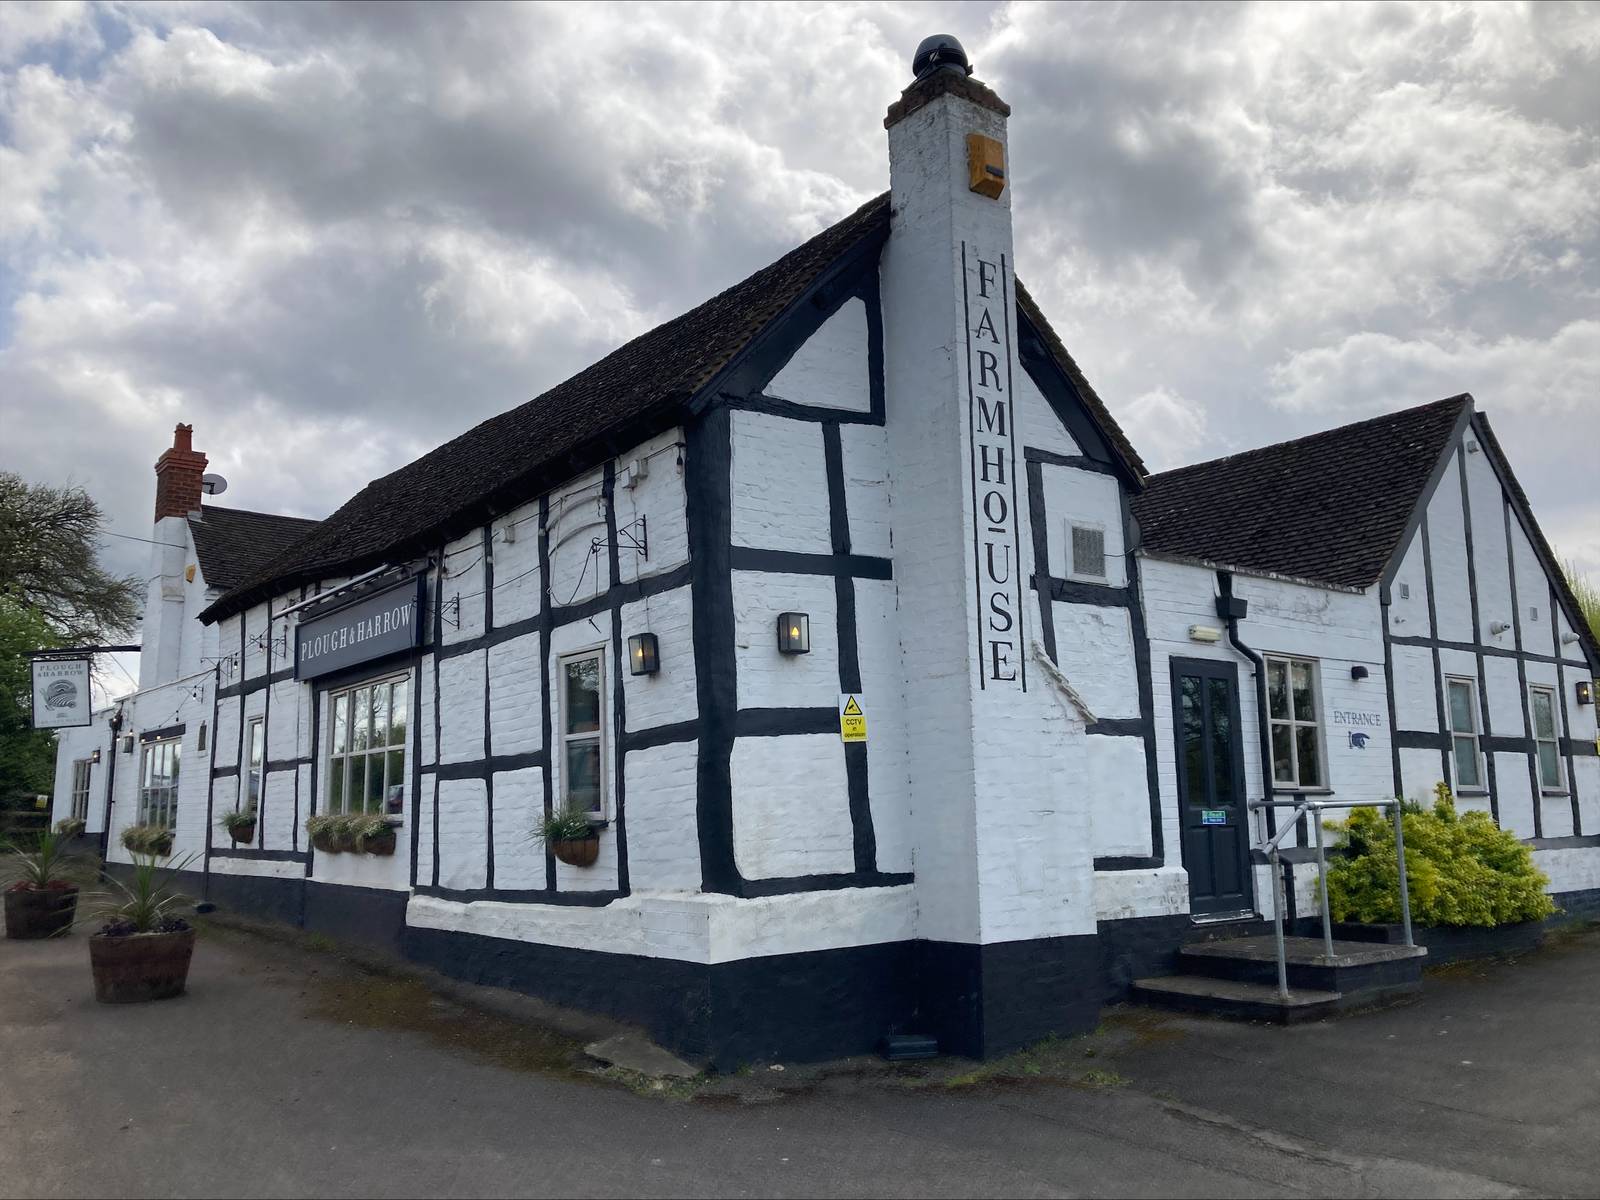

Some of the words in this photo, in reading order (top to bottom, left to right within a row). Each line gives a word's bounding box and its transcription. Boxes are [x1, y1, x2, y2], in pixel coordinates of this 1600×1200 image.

[976, 260, 1016, 681] FARMHOUSE
[40, 663, 81, 671] PLOUGH
[1334, 711, 1381, 726] ENTRANCE
